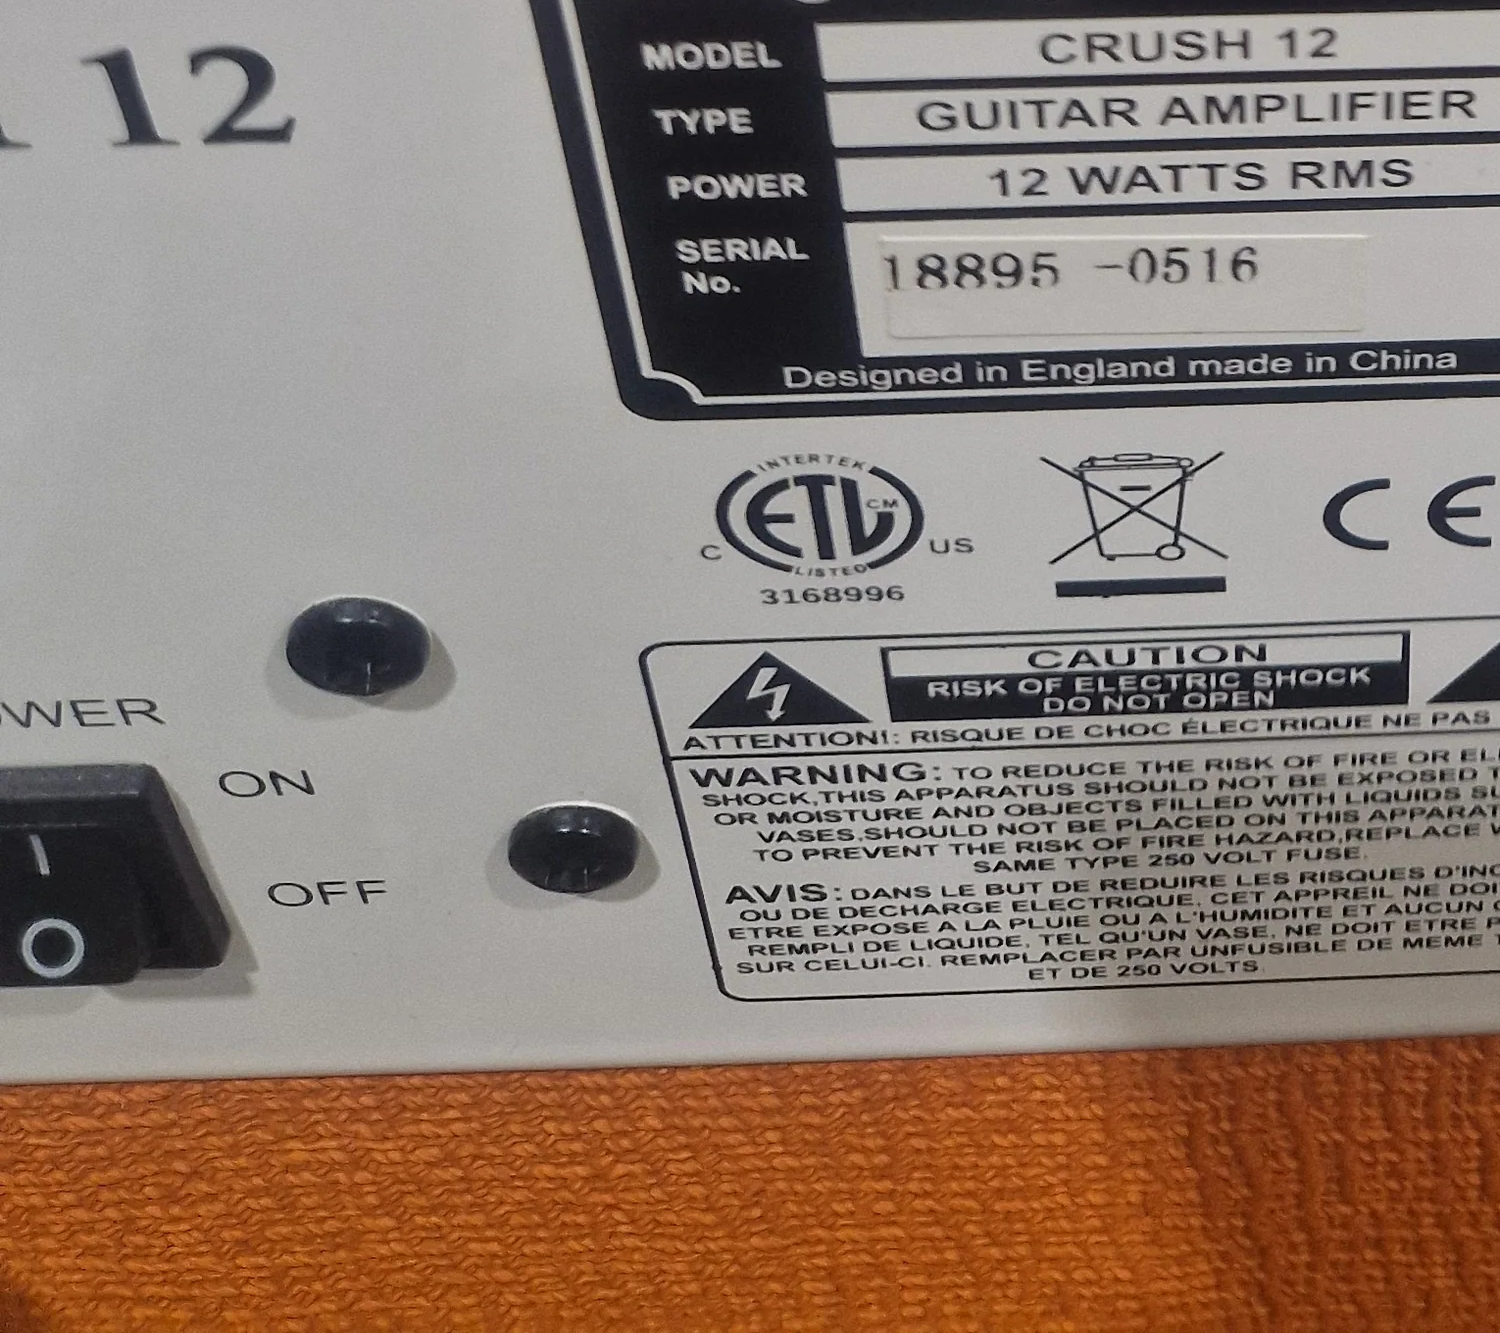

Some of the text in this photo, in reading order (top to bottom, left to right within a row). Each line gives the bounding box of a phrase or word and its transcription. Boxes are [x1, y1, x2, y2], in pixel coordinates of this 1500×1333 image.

[641, 41, 783, 71] MODEL
[1038, 27, 1338, 65] CRUSH 12
[81, 45, 296, 147] 12
[915, 89, 1477, 132] GUITAR AMPLIFIER
[652, 107, 754, 136] TYPE
[667, 172, 808, 200] POWER
[989, 158, 1414, 198] 12 WATTS RMS
[675, 236, 810, 264] SERIAL
[681, 271, 741, 295] No.
[782, 348, 1458, 391] Designed in England made in China
[756, 453, 866, 472] INTERTEK
[929, 537, 975, 555] US
[759, 585, 905, 605] 3168996
[1027, 642, 1267, 670] CAUTION
[927, 666, 1371, 699] RISK OF ELECTRIC SHOCK
[0, 698, 166, 729] WER
[1042, 689, 1274, 714] DO NOT OPEN
[910, 727, 1024, 744] RISQUE
[1034, 725, 1074, 740] DE
[1083, 722, 1170, 738] CHOC
[1181, 715, 1369, 735] ÉLECTRIQUE
[1382, 713, 1420, 728] NE
[1431, 711, 1490, 726] PAS
[688, 761, 942, 788] WARNING:
[951, 766, 993, 781] TO
[1001, 761, 1126, 779] REDUCE
[1136, 759, 1195, 775] THE
[1204, 756, 1273, 772] RISK
[1283, 754, 1322, 769] OF
[1333, 752, 1397, 767] FIRE
[1407, 749, 1450, 764] OR
[1083, 777, 1208, 795] SHOULD
[1217, 775, 1278, 791] NOT
[1288, 772, 1326, 789] BE
[1337, 767, 1478, 786] EXPOSED
[218, 769, 316, 798] ON
[713, 812, 759, 826] OR
[766, 807, 923, 825] MOISTURE
[931, 804, 995, 819] AND
[1003, 798, 1142, 817] OBJECTS
[1151, 795, 1253, 812] FILLED
[1262, 791, 1335, 807] WITH
[1345, 786, 1461, 805] LIQUIDS
[996, 820, 1057, 836] NOT
[1067, 818, 1106, 834] BE
[1115, 814, 1235, 832] PLACED
[1244, 812, 1286, 827] ON
[1296, 809, 1360, 825] THIS
[752, 848, 793, 862] TO
[801, 843, 940, 861] PREVENT
[947, 841, 1006, 856] THE
[1015, 838, 1084, 854] RISK
[1092, 836, 1131, 851] OF
[1141, 834, 1204, 849] FIRE
[973, 858, 1056, 873] SAME
[1064, 854, 1139, 870] TYPE
[1148, 852, 1195, 867] 250
[1202, 849, 1277, 865] VOLT
[267, 879, 387, 908] OFF
[724, 883, 843, 905] AVIS:
[850, 885, 932, 901] DANS
[940, 883, 976, 898] LE
[985, 881, 1043, 896] BUT
[1052, 879, 1090, 894] DE
[1099, 874, 1227, 891] REDUIRE
[1236, 871, 1290, 887] LES
[1299, 866, 1425, 885] RISQUES
[739, 908, 782, 922] OU
[791, 907, 830, 920] DE
[838, 900, 1002, 919] DECHARGE
[1210, 890, 1265, 905] CET
[1273, 885, 1394, 903] APPREIL
[1403, 883, 1439, 898] NE
[727, 925, 804, 940] ETRE
[812, 921, 930, 937] EXPOSE
[937, 920, 957, 933] A
[964, 918, 1002, 932] LA
[1009, 914, 1090, 930] PLUIE
[1099, 913, 1140, 927] OU
[1148, 912, 1168, 925] A
[1342, 903, 1376, 918] ET
[1383, 900, 1483, 916] AUCUN
[747, 941, 855, 957] REMPLI
[862, 939, 901, 953] DE
[1038, 932, 1091, 946] TEL
[1285, 923, 1321, 938] NE
[1331, 920, 1396, 936] DOIT
[1404, 917, 1476, 933] ETRE
[736, 960, 796, 974] SUR
[940, 948, 1117, 967] REMPLACER
[1126, 946, 1181, 961] PAR
[1190, 938, 1346, 958] UNFUSIBLE
[1356, 937, 1393, 952] DE
[1402, 933, 1483, 950] MEME
[1028, 967, 1062, 981] ET
[1070, 965, 1108, 979] DE
[1116, 963, 1161, 978] 250
